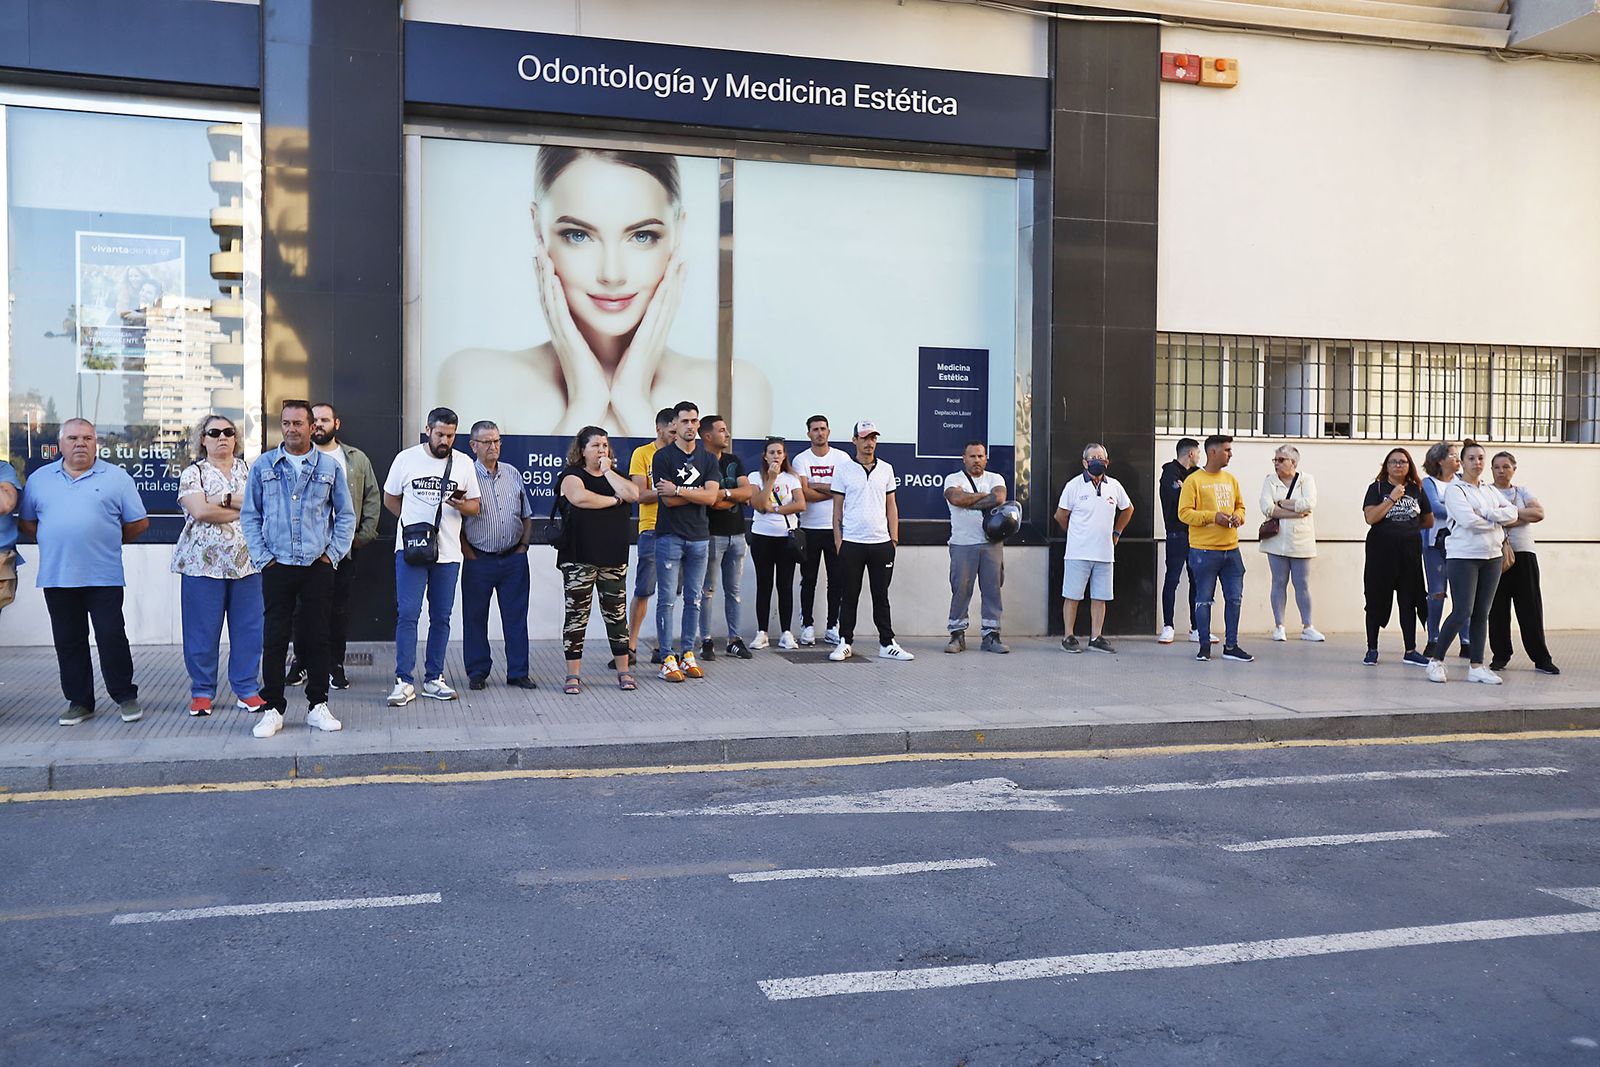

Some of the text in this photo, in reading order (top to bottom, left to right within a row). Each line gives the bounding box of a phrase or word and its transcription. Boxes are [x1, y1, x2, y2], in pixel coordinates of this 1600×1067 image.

[517, 54, 958, 116] Odontología y Medicina Estética
[937, 363, 971, 372] Medicina
[938, 373, 969, 382] Estética
[115, 444, 134, 459] tu
[138, 444, 176, 460] cita:
[528, 453, 563, 467] Pide
[132, 463, 181, 479] 25 75
[522, 470, 552, 485] 959
[435, 481, 457, 491] CST
[904, 474, 943, 487] PAGO
[407, 538, 428, 548] FILA
